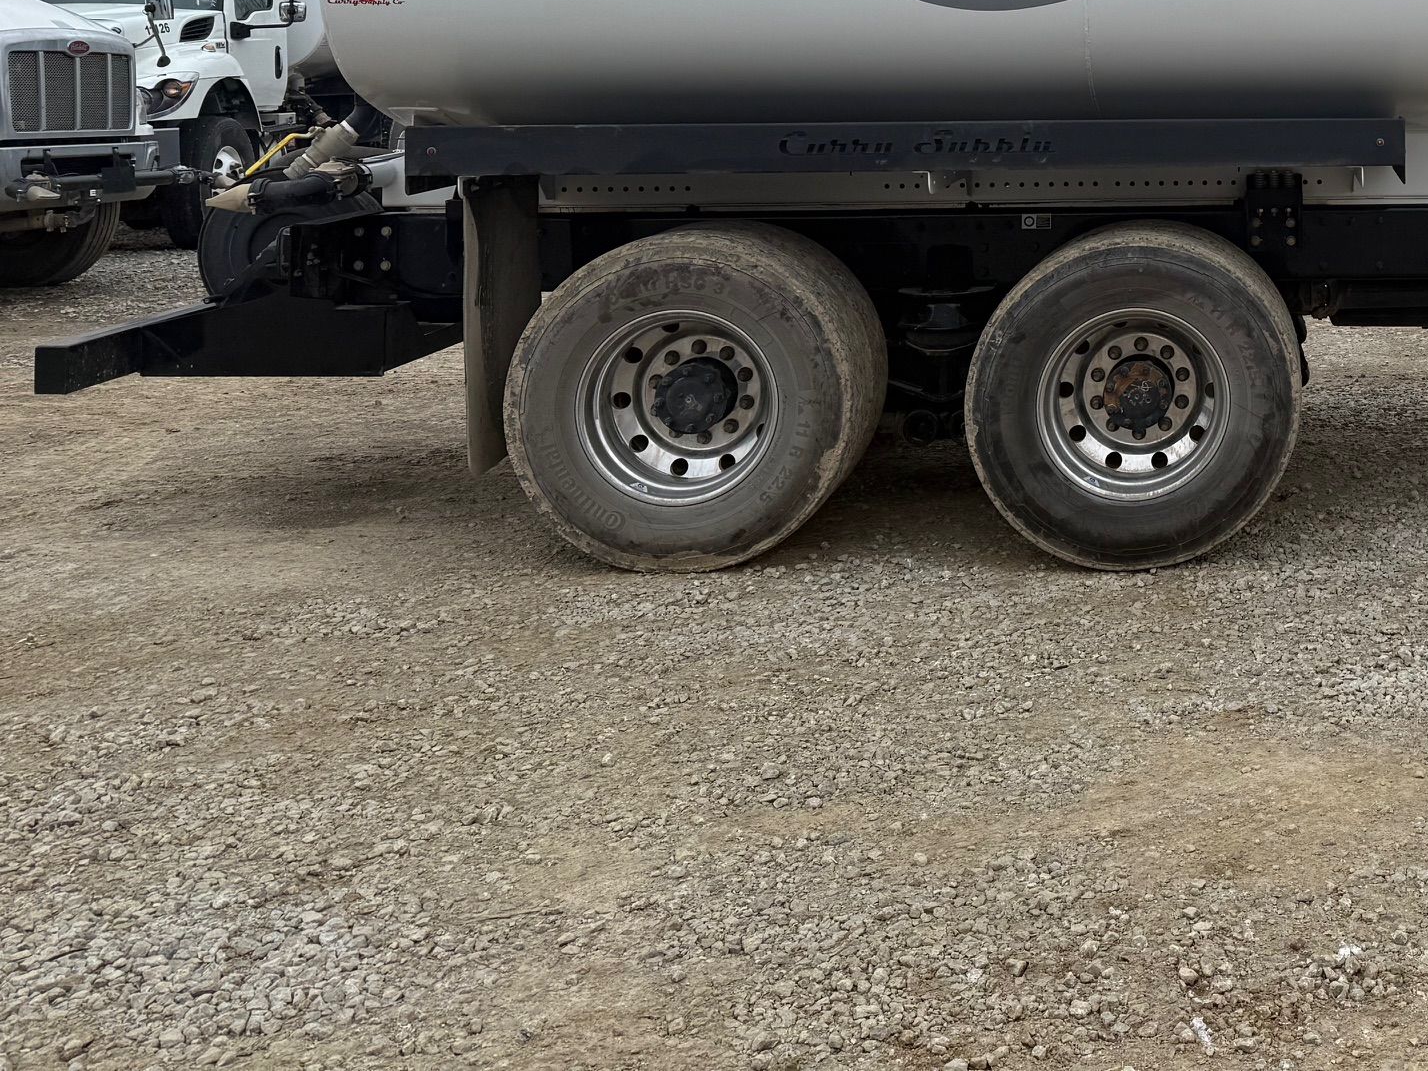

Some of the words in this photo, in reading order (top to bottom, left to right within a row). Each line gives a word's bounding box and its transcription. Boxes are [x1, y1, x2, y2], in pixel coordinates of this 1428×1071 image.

[145, 23, 171, 35] 126
[778, 130, 893, 160] Curry
[912, 129, 1056, 160] Supply
